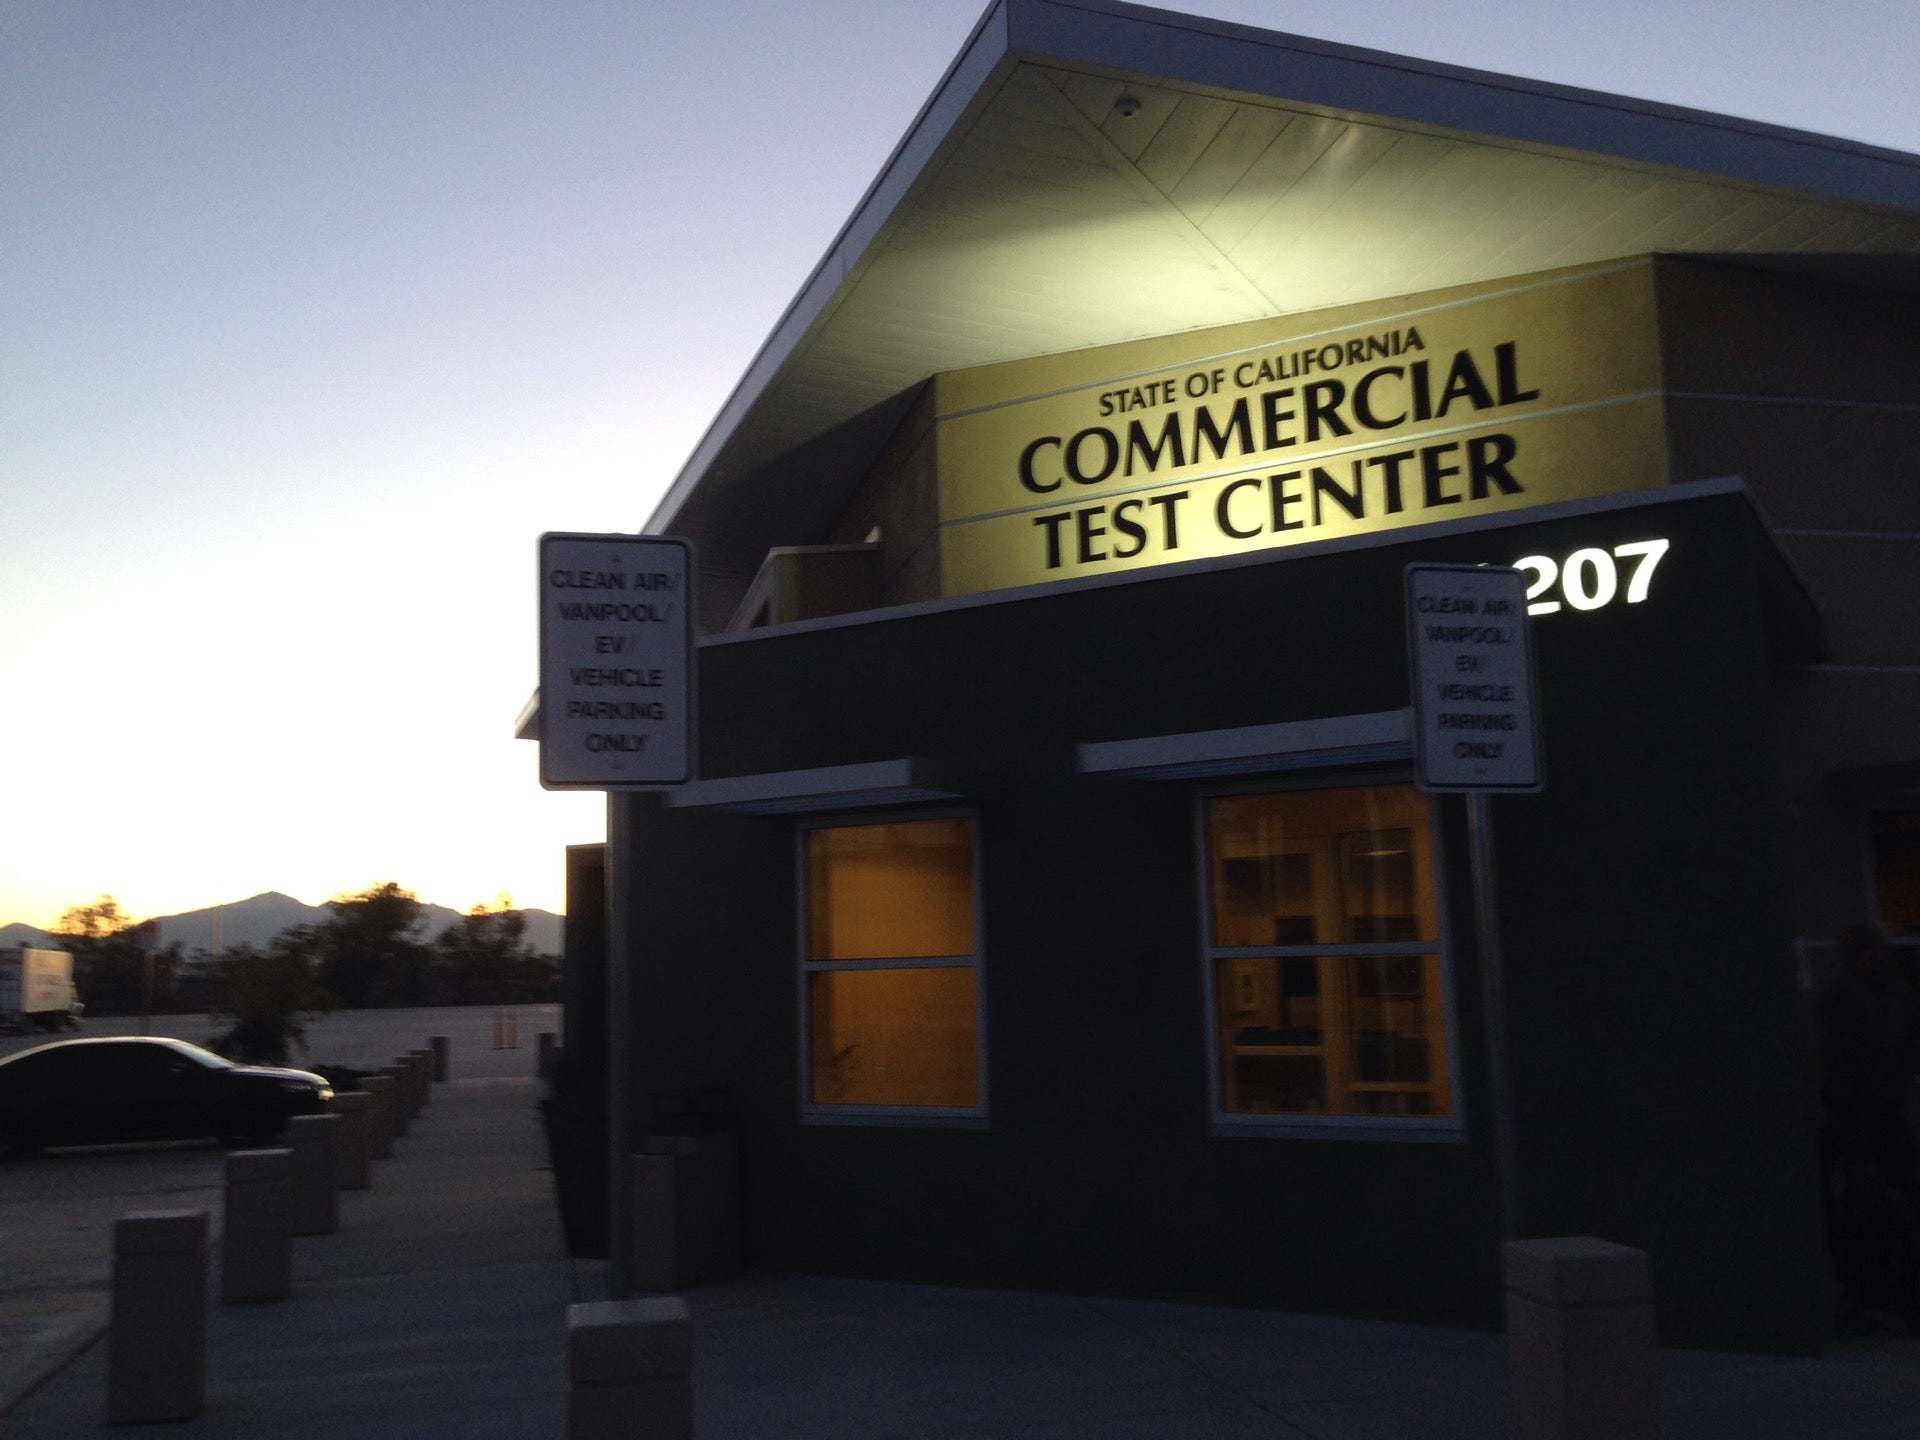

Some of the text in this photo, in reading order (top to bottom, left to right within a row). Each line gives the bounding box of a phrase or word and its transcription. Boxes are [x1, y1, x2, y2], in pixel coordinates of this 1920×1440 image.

[1099, 326, 1425, 417] STATE OF CALIFORNIA
[1018, 341, 1540, 494] COMMERCIAL
[1034, 433, 1525, 570] TEST CENTER
[550, 568, 626, 591] CLEAN
[1476, 538, 1670, 617] 207
[1418, 596, 1475, 615] CLEAN
[568, 667, 666, 688] VEHICLE
[1436, 683, 1514, 702] VEHICLE
[567, 700, 667, 721] PARKING
[1437, 712, 1518, 732] PARKING
[584, 732, 650, 753] ONLY
[1453, 741, 1505, 760] ONLY
